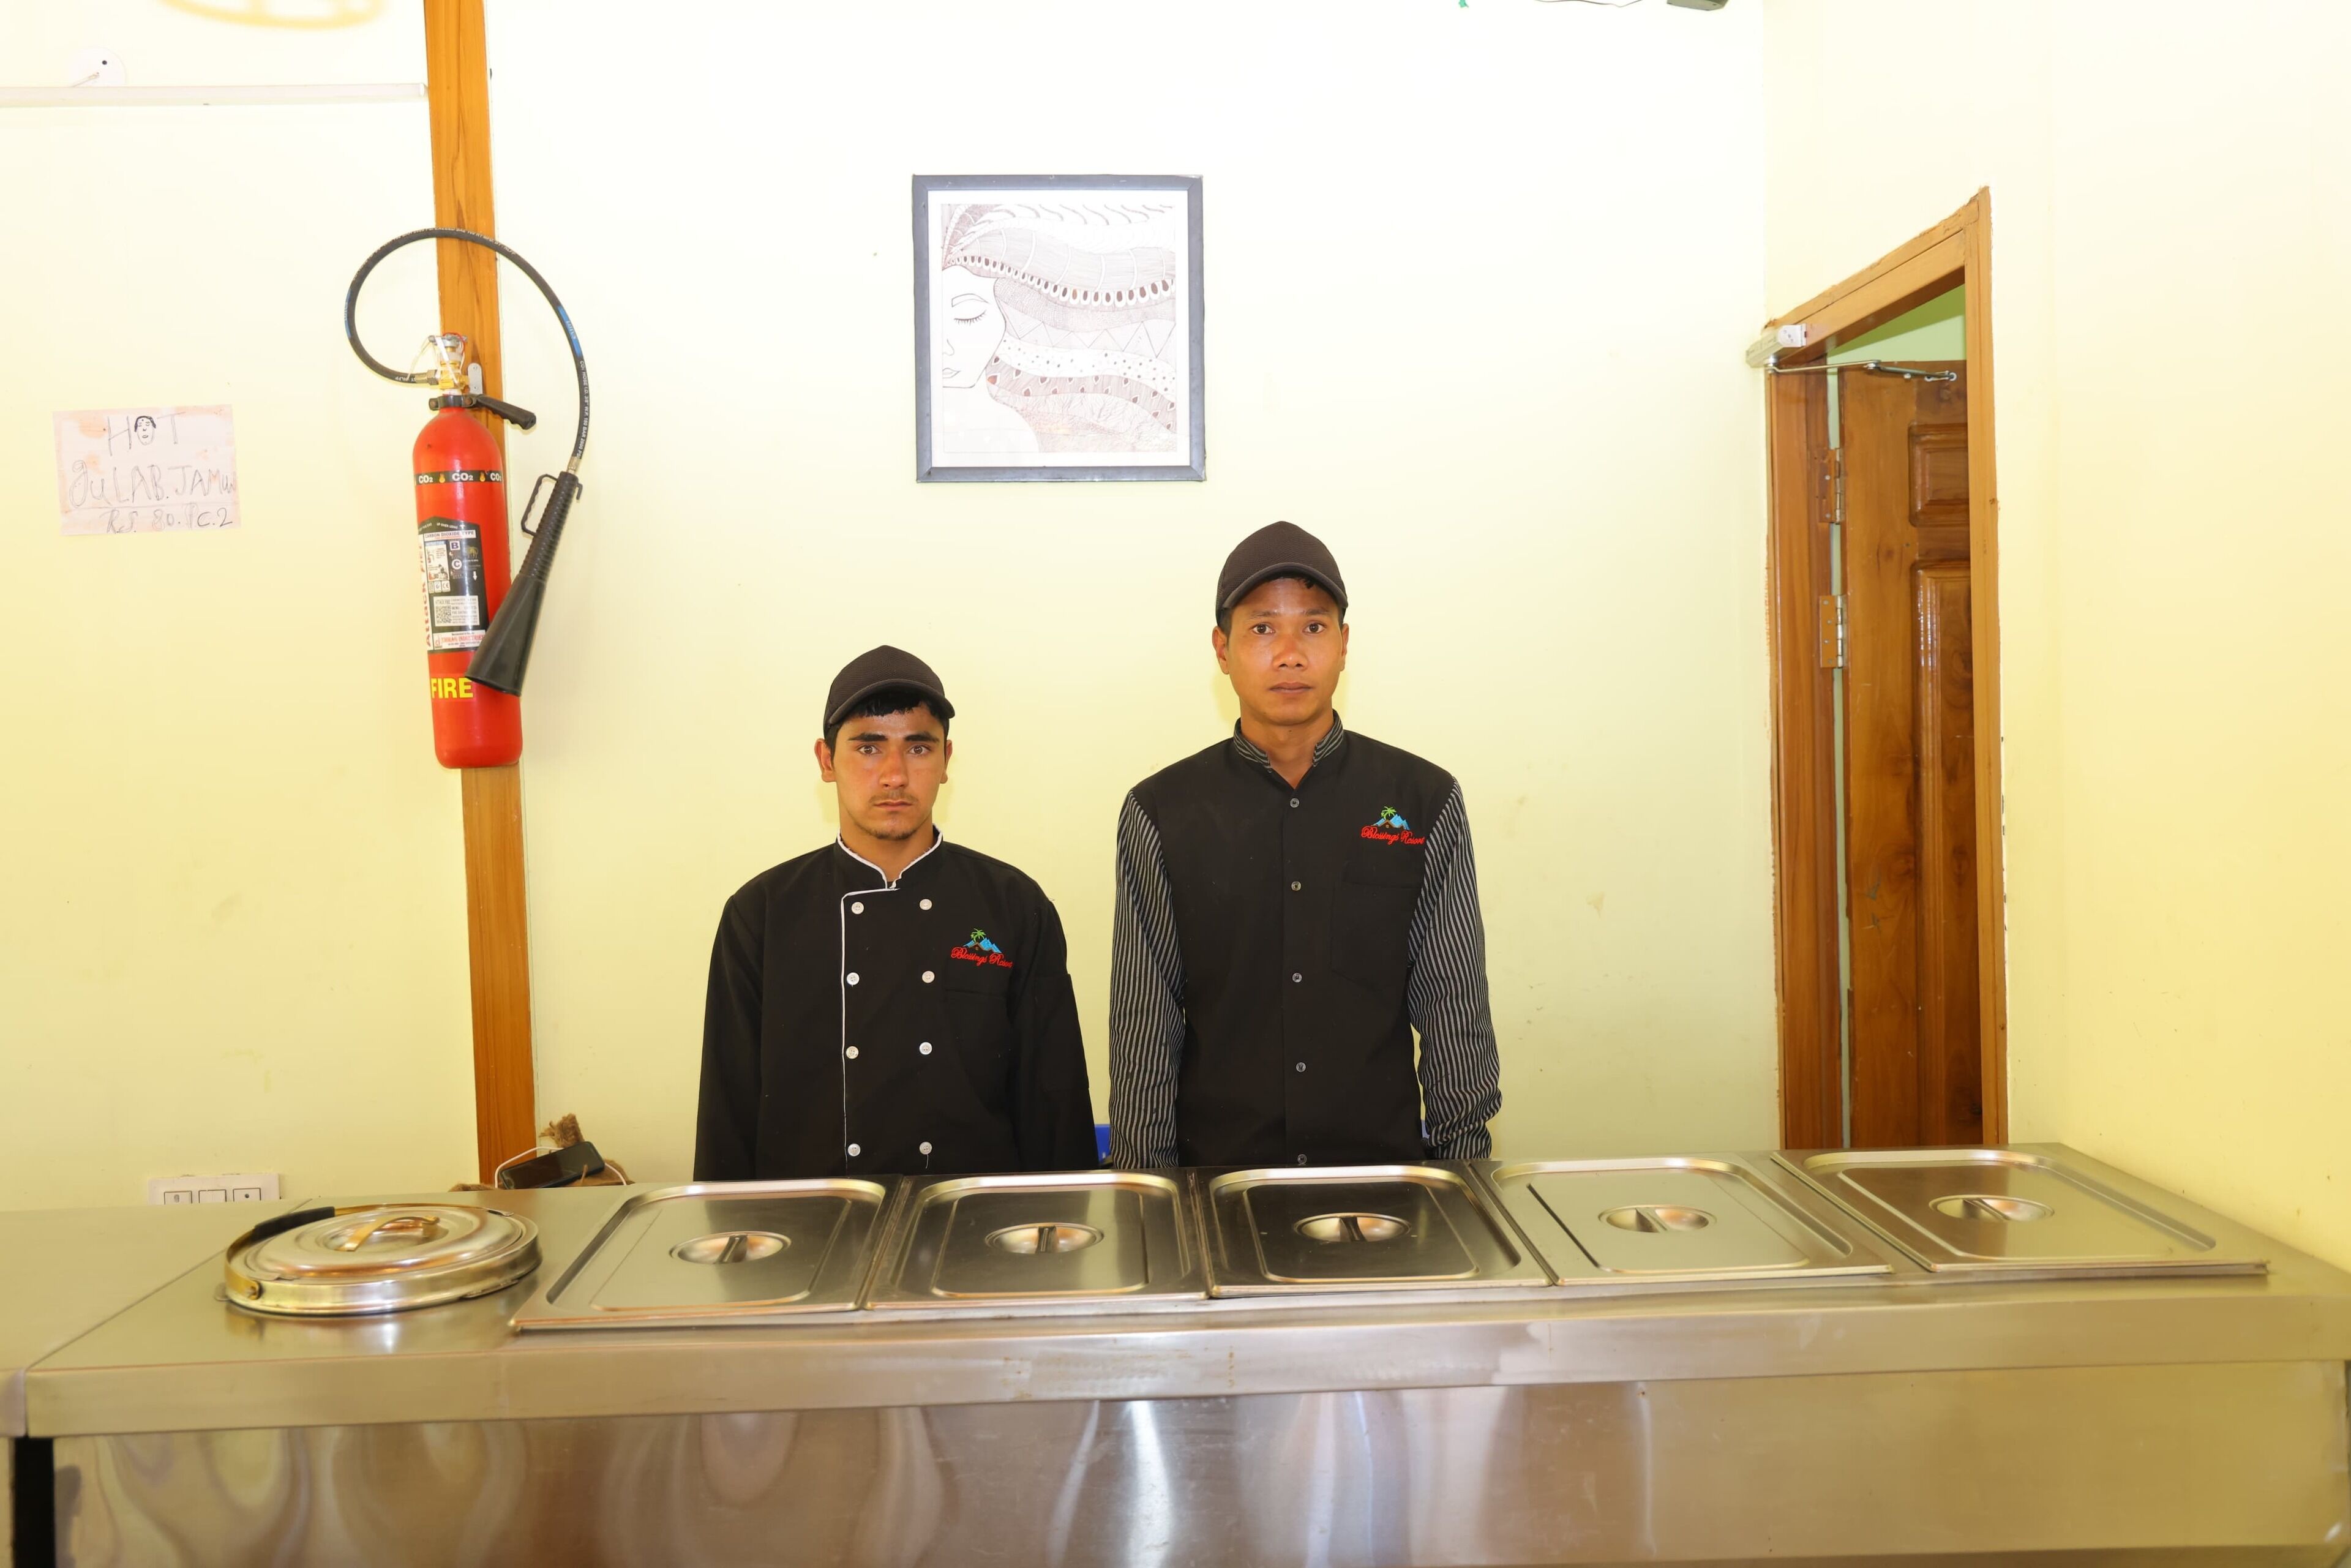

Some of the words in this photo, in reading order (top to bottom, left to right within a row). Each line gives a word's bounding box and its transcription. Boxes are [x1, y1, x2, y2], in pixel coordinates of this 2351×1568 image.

[107, 411, 186, 456] HOT
[418, 475, 433, 484] CO2
[452, 472, 474, 481] CO2
[430, 677, 474, 699] FIRE
[1360, 825, 1400, 845] Blessings
[1400, 830, 1425, 844] Resort
[950, 947, 988, 967] Blessings
